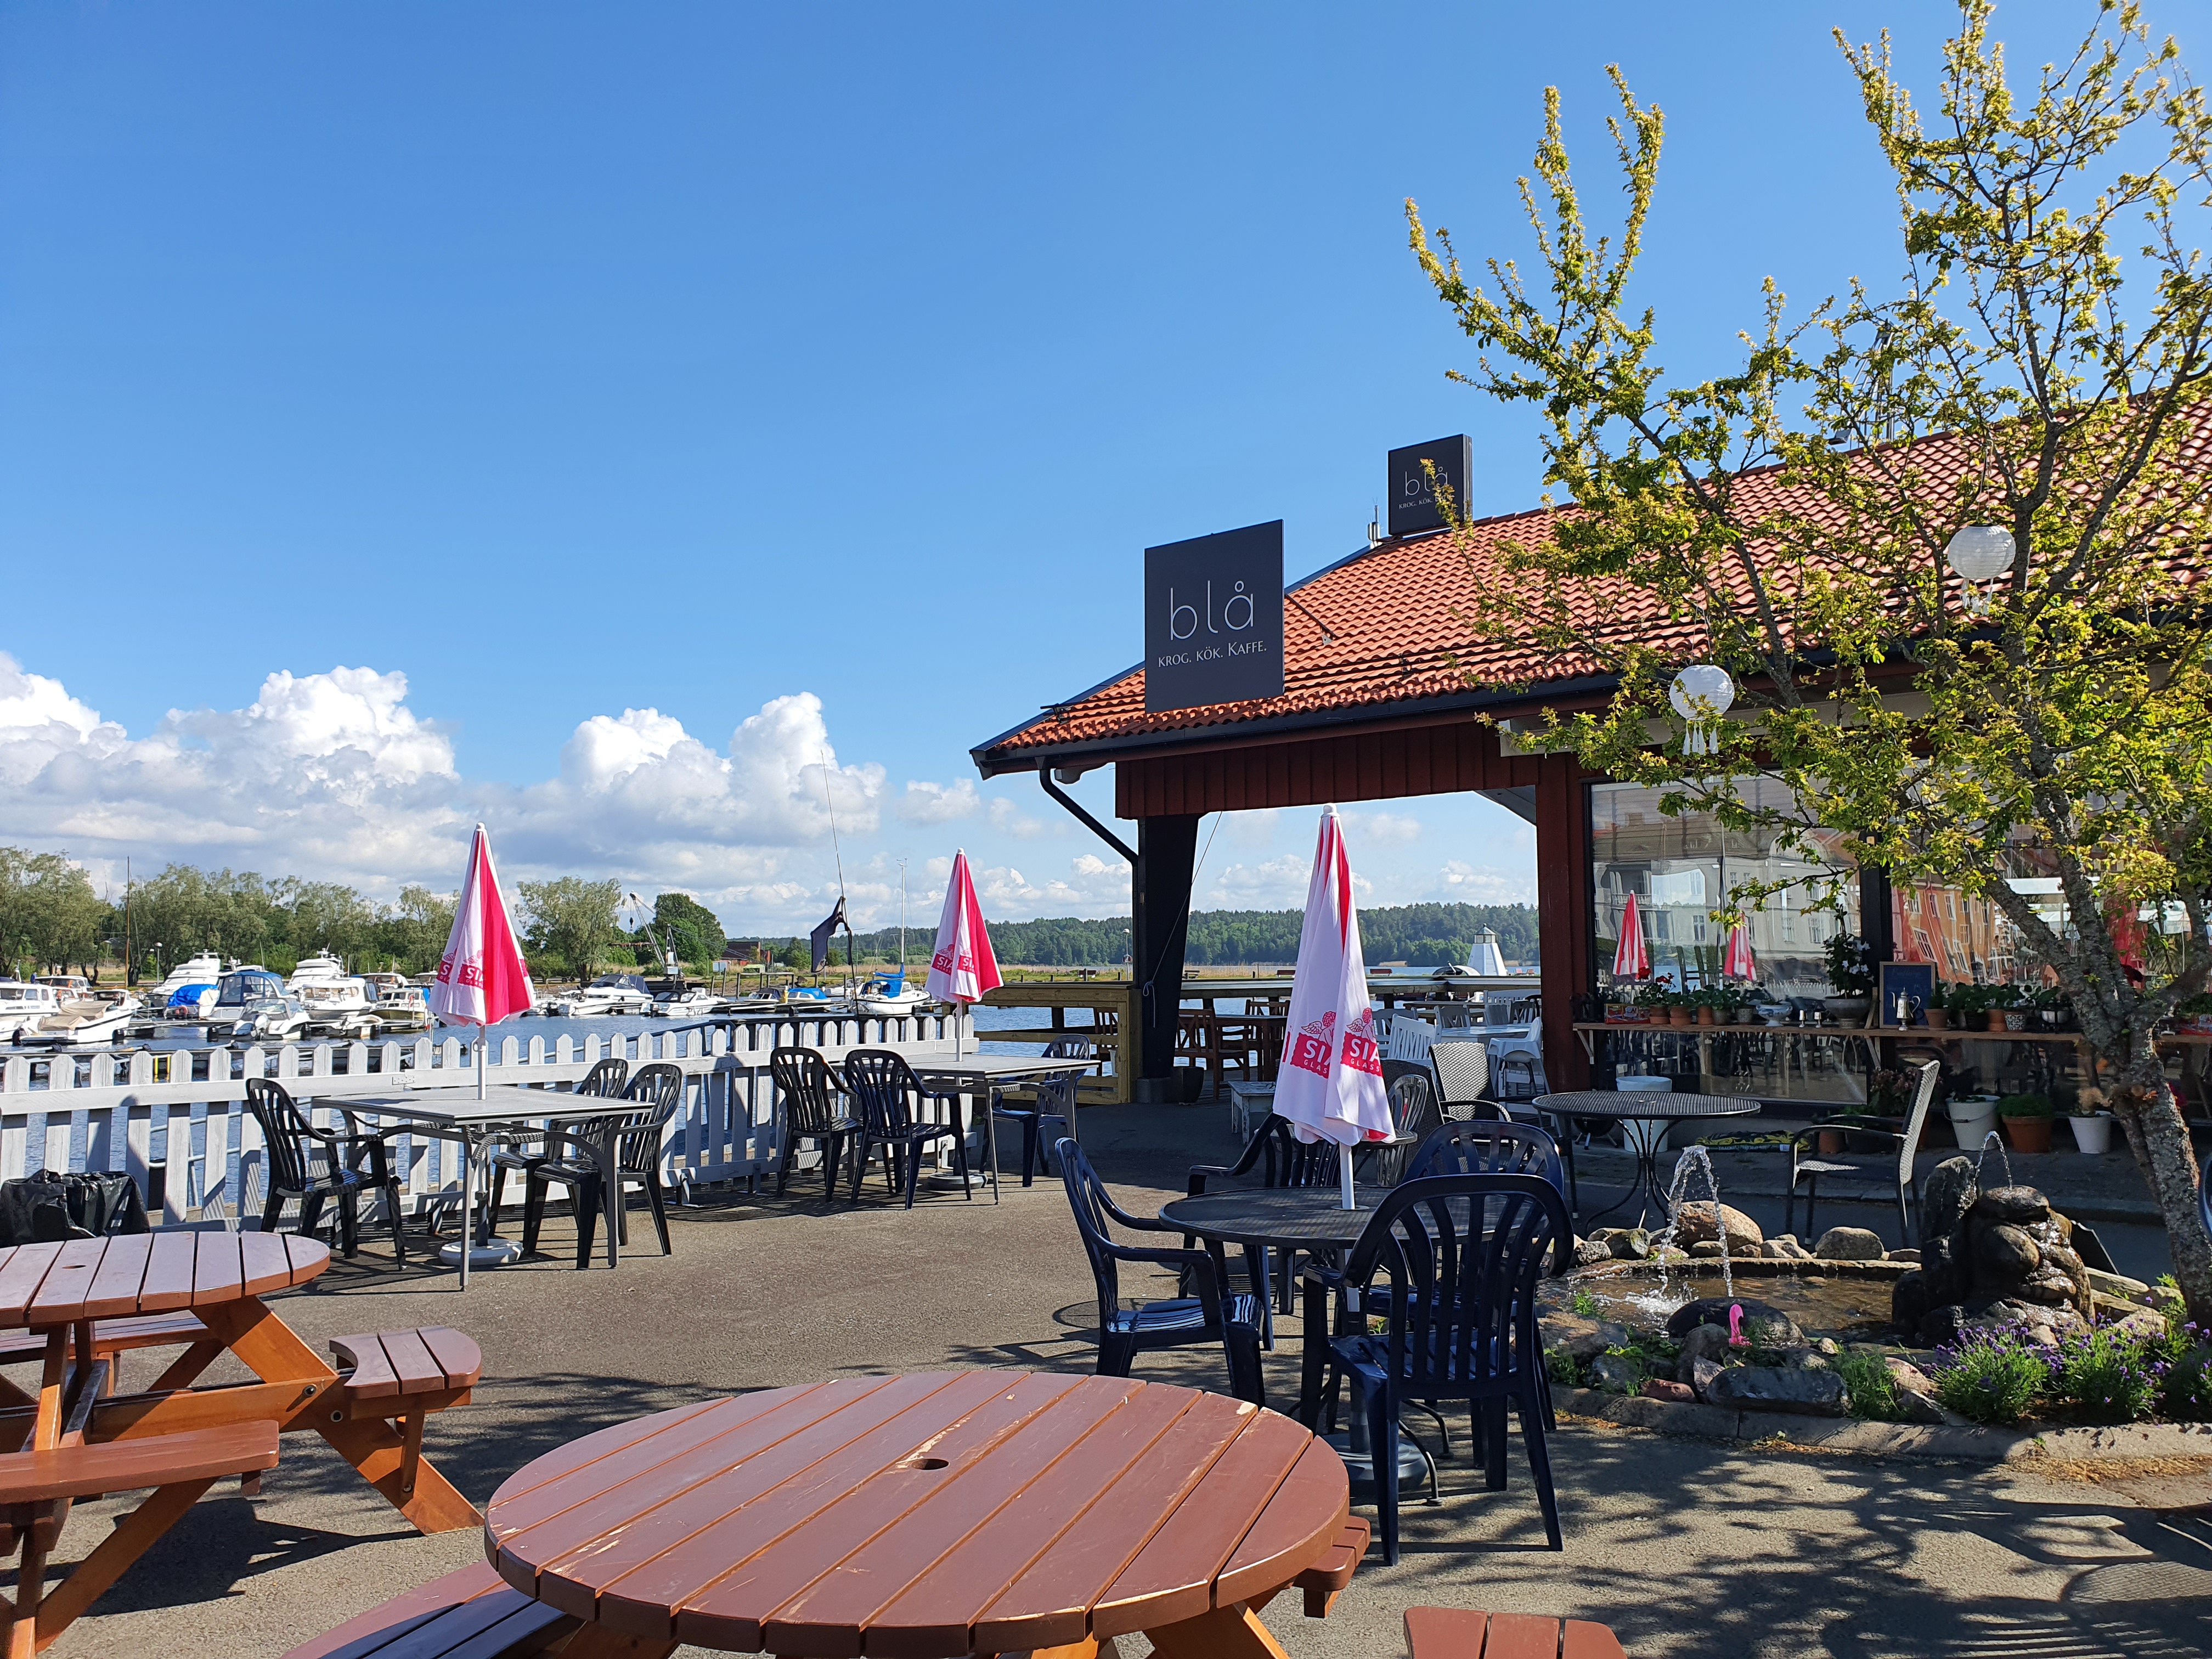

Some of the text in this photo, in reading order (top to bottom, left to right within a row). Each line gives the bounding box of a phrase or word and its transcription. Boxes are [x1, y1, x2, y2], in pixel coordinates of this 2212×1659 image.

[1405, 464, 1448, 496] blå
[1398, 501, 1417, 510] KROG.
[1419, 497, 1433, 505] KÖK.
[1170, 580, 1254, 641] blå
[1158, 653, 1192, 668] KROG.
[1196, 646, 1223, 662] KÖK.
[1350, 1038, 1381, 1065] SIA
[1350, 1058, 1380, 1073] GLASS
